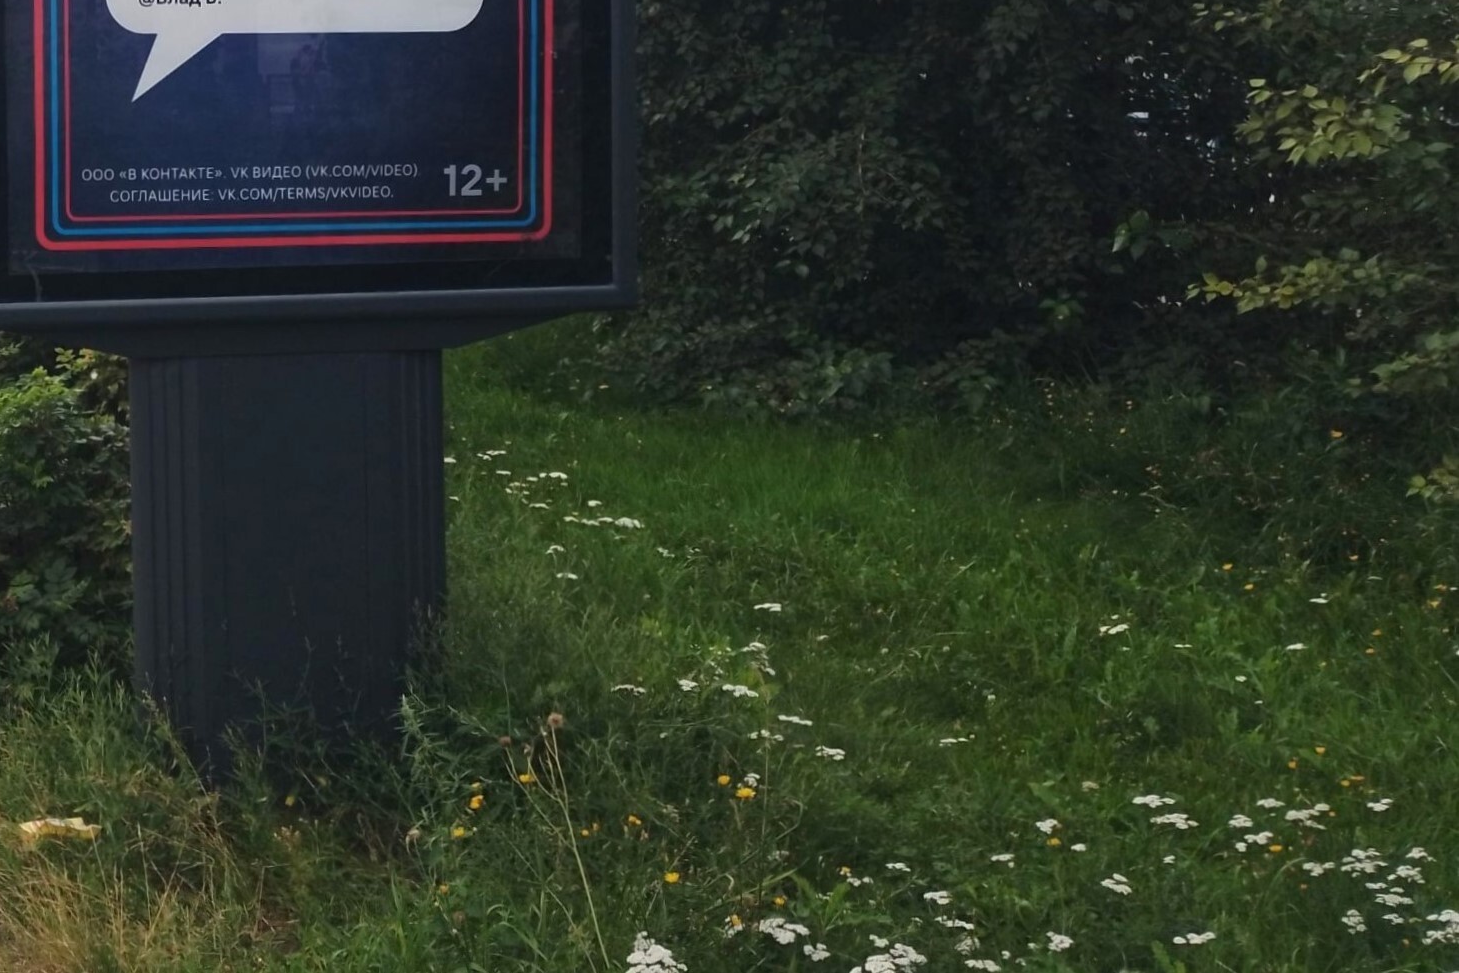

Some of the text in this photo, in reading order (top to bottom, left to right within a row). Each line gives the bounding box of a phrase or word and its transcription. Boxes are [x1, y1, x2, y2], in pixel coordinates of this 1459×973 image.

[81, 168, 115, 181] ООО
[119, 168, 137, 180] «В
[231, 166, 249, 178] VK
[252, 166, 302, 179] ВИДЕО
[443, 164, 508, 197] 12+
[109, 186, 394, 203] СОГЛАШЕНИЕ: VK.COM/TERMS/VKVIDEO.
